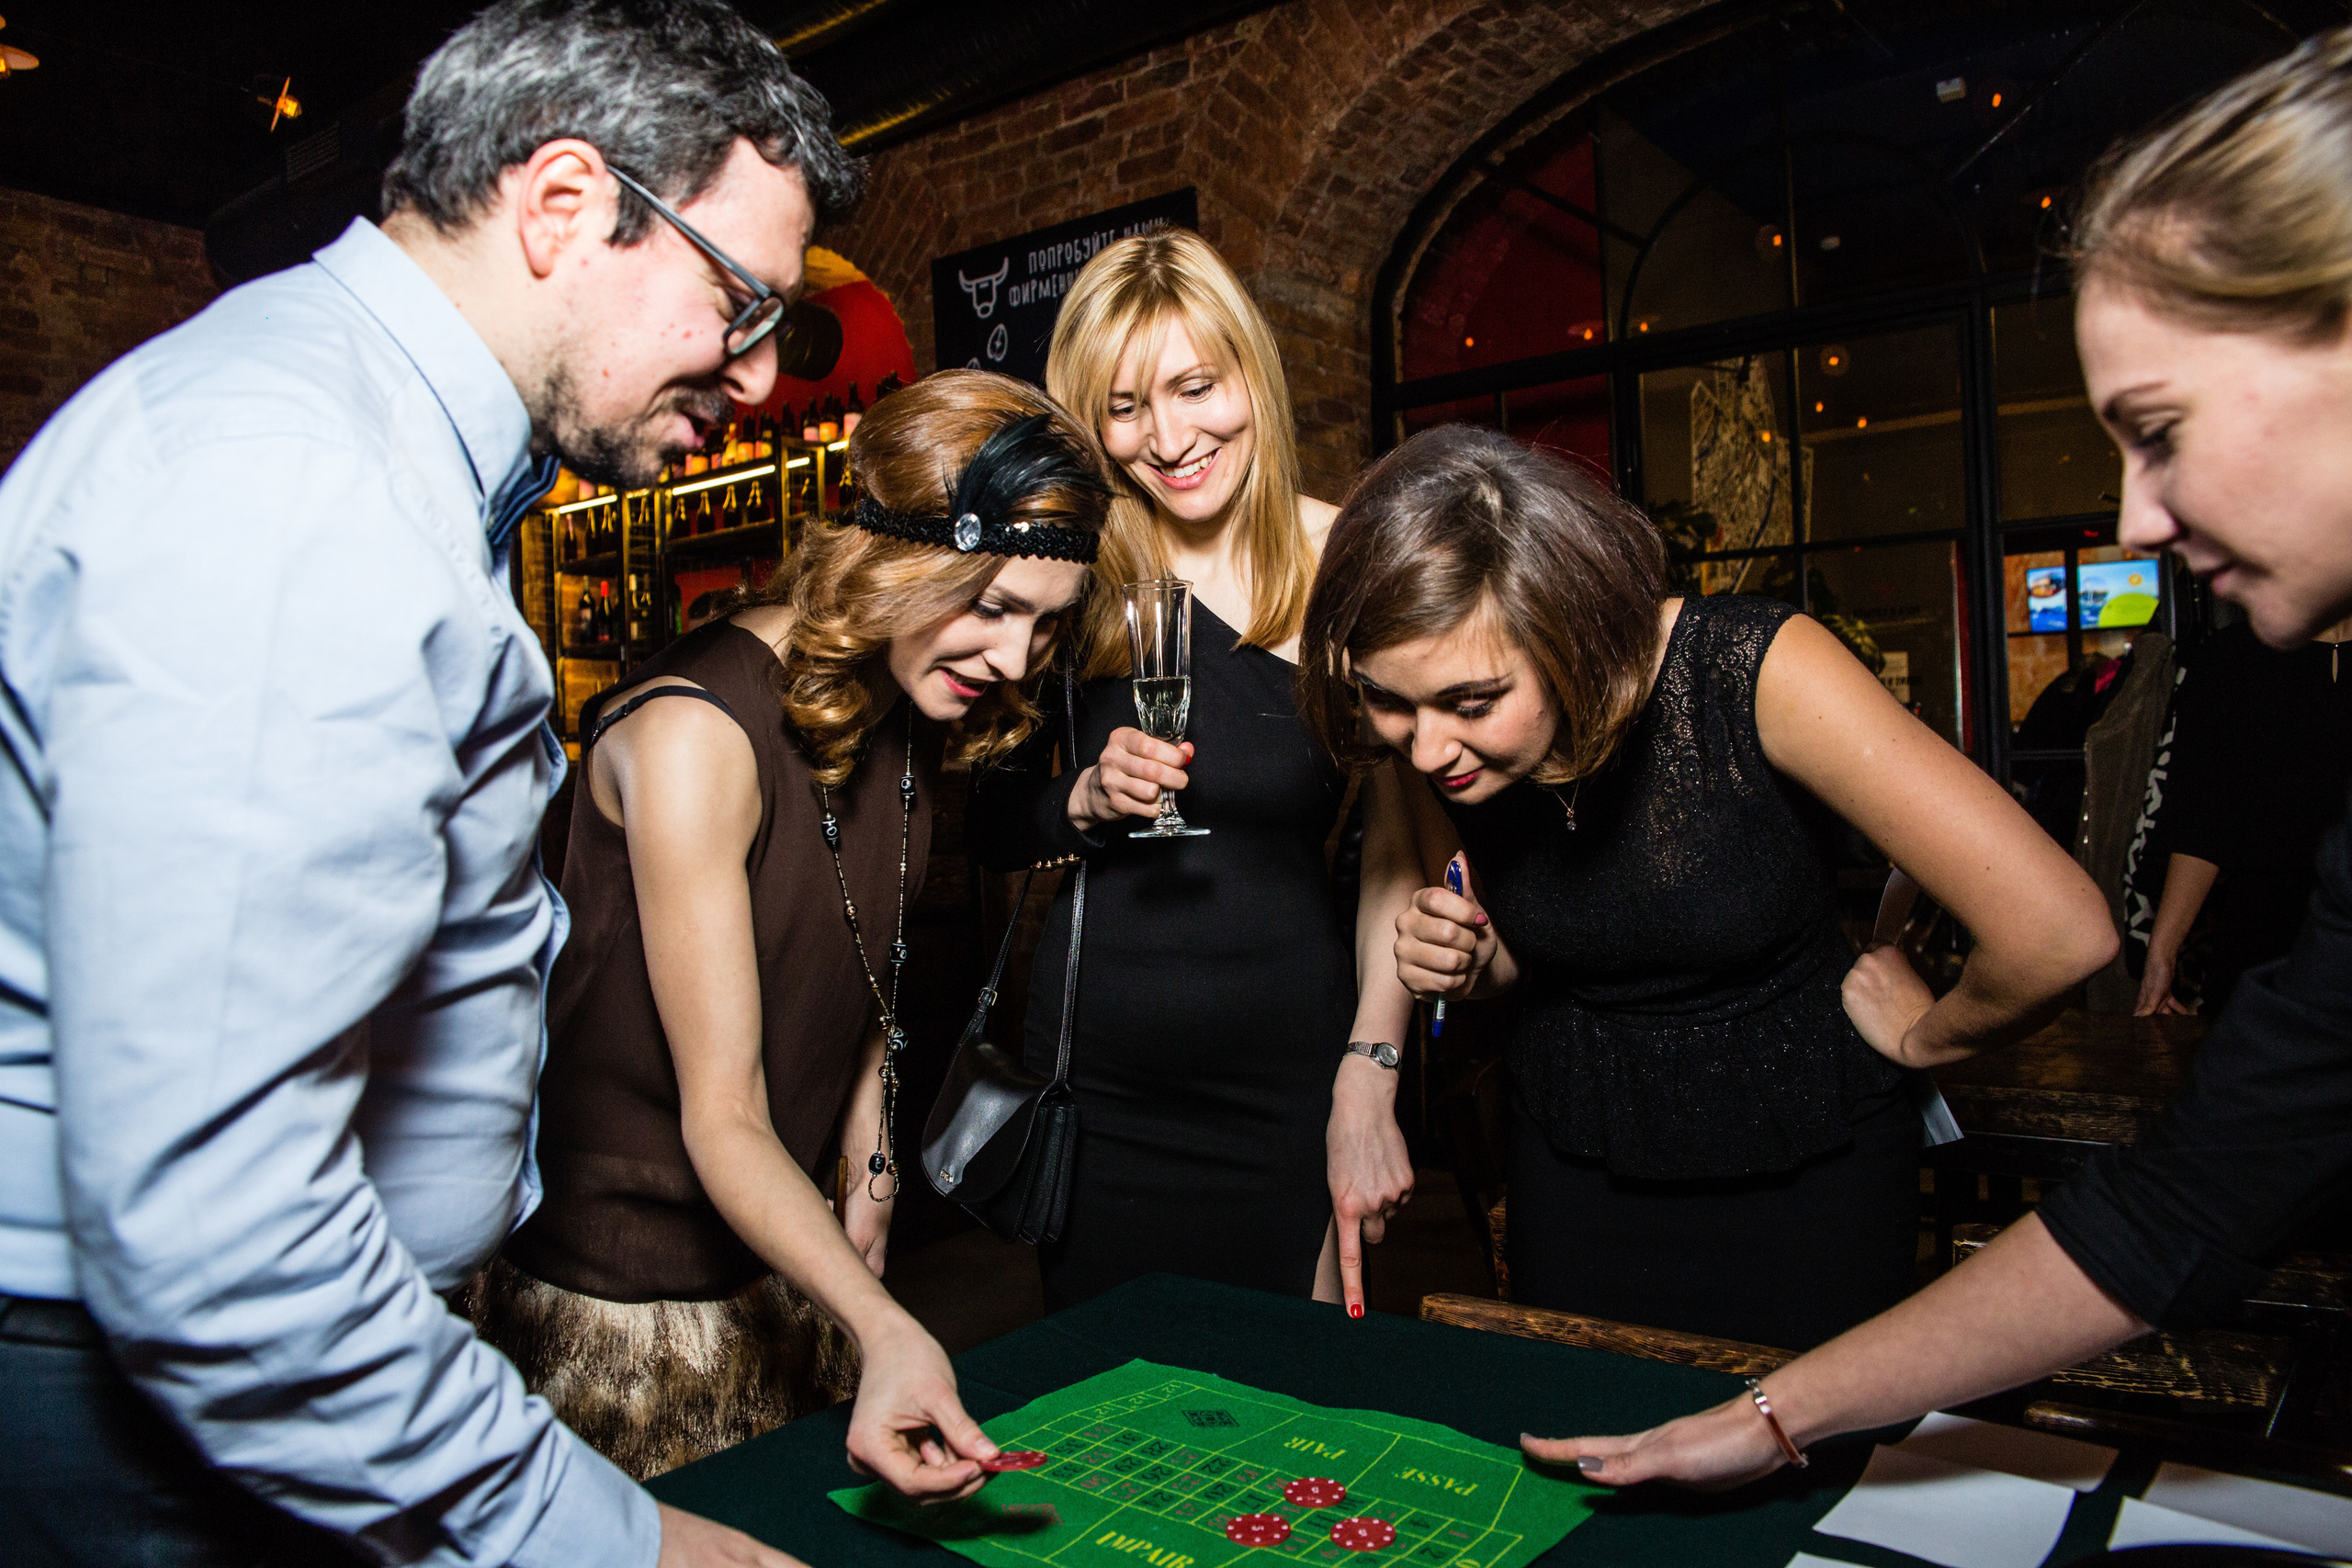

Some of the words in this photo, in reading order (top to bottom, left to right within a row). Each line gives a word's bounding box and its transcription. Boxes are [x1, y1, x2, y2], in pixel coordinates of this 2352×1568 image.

[1028, 228, 1116, 275] ПОПРОБУЙТЕ
[1009, 267, 1082, 308] ФИРМЕНН
[1283, 1437, 1346, 1460] PAIR
[1394, 1466, 1479, 1497] PASSE
[1095, 1530, 1195, 1568] IMPAIR
